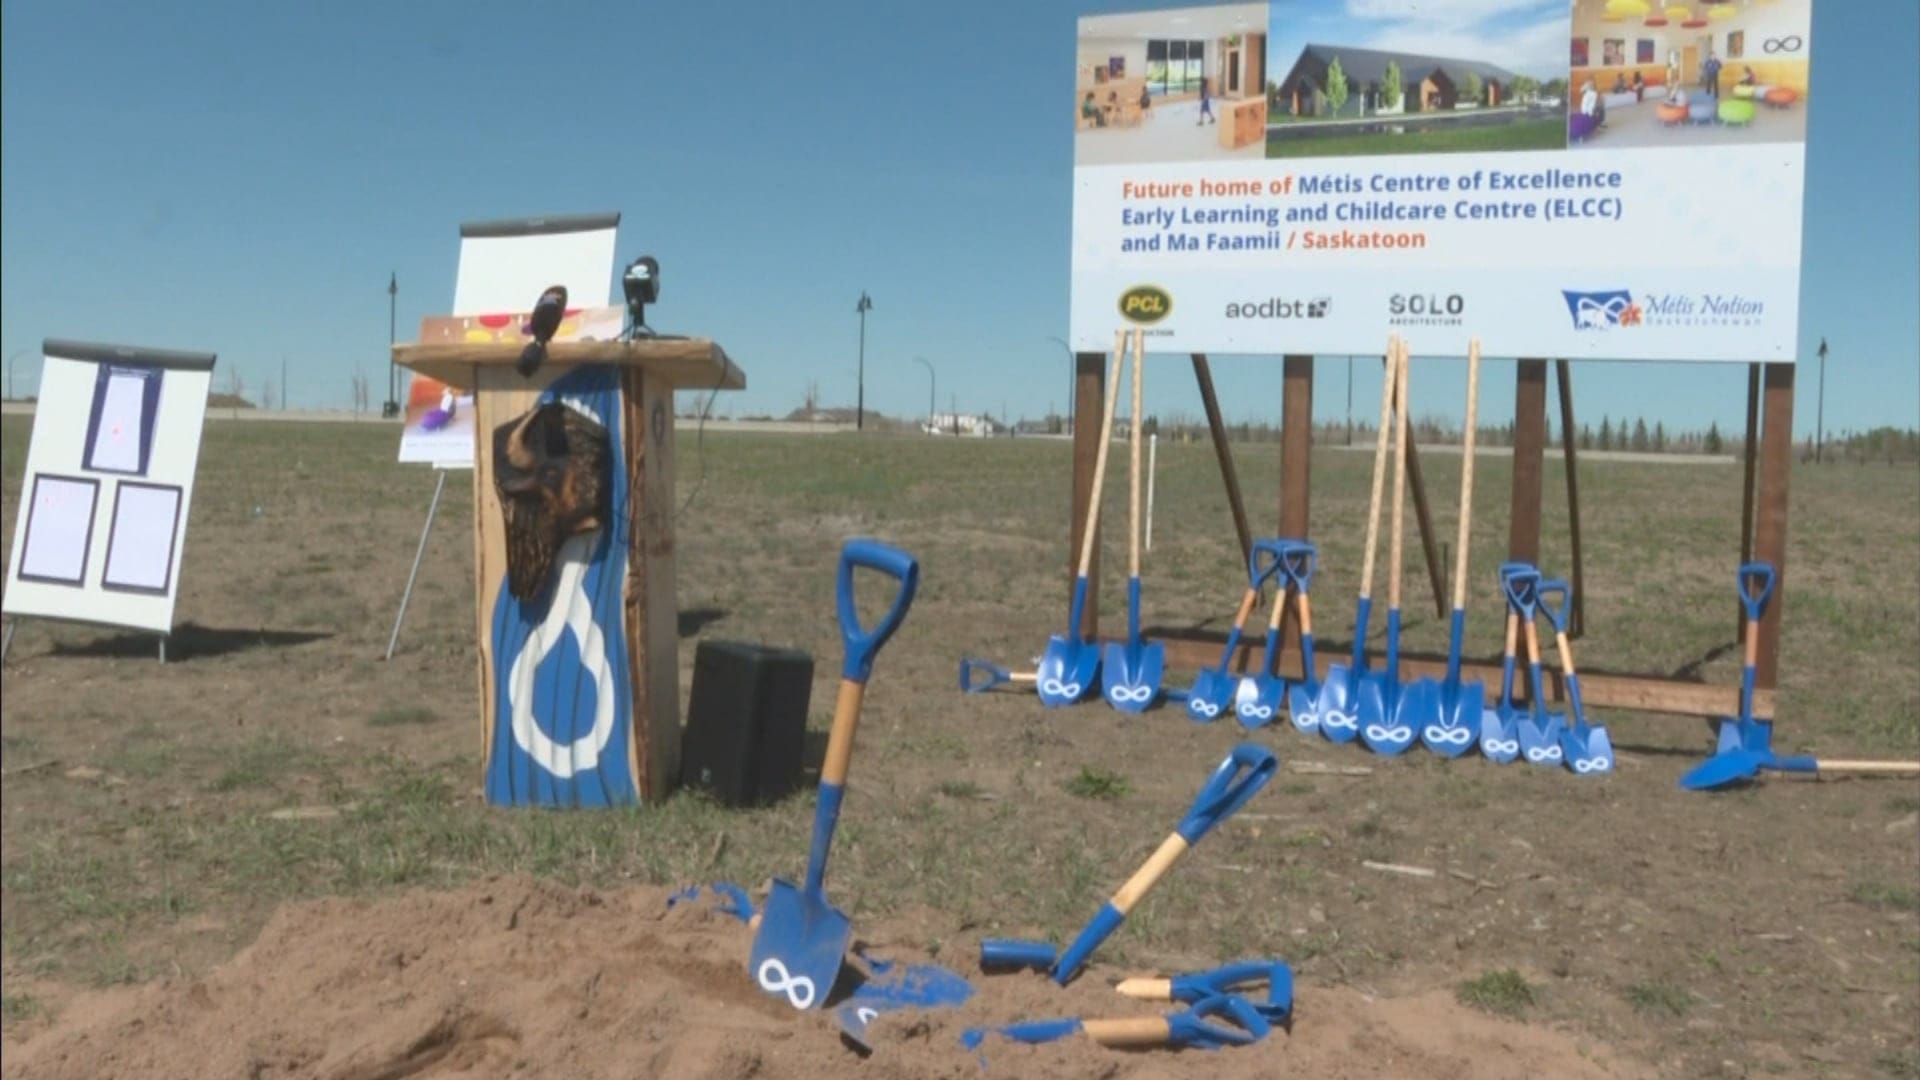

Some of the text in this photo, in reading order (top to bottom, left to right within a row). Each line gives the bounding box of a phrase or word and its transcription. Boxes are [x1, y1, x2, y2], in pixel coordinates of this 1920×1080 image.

[1122, 169, 1623, 199] Future home of Métis Centre of Excellence
[1121, 198, 1623, 231] Early Learning and Childcare Centre (ELCC)
[1121, 230, 1426, 252] and Ma Faamii / Saskatoon
[1126, 296, 1163, 312] PCL
[1225, 298, 1304, 320] aodbt
[1389, 294, 1464, 315] SOLO
[1700, 295, 1764, 315] Nation
